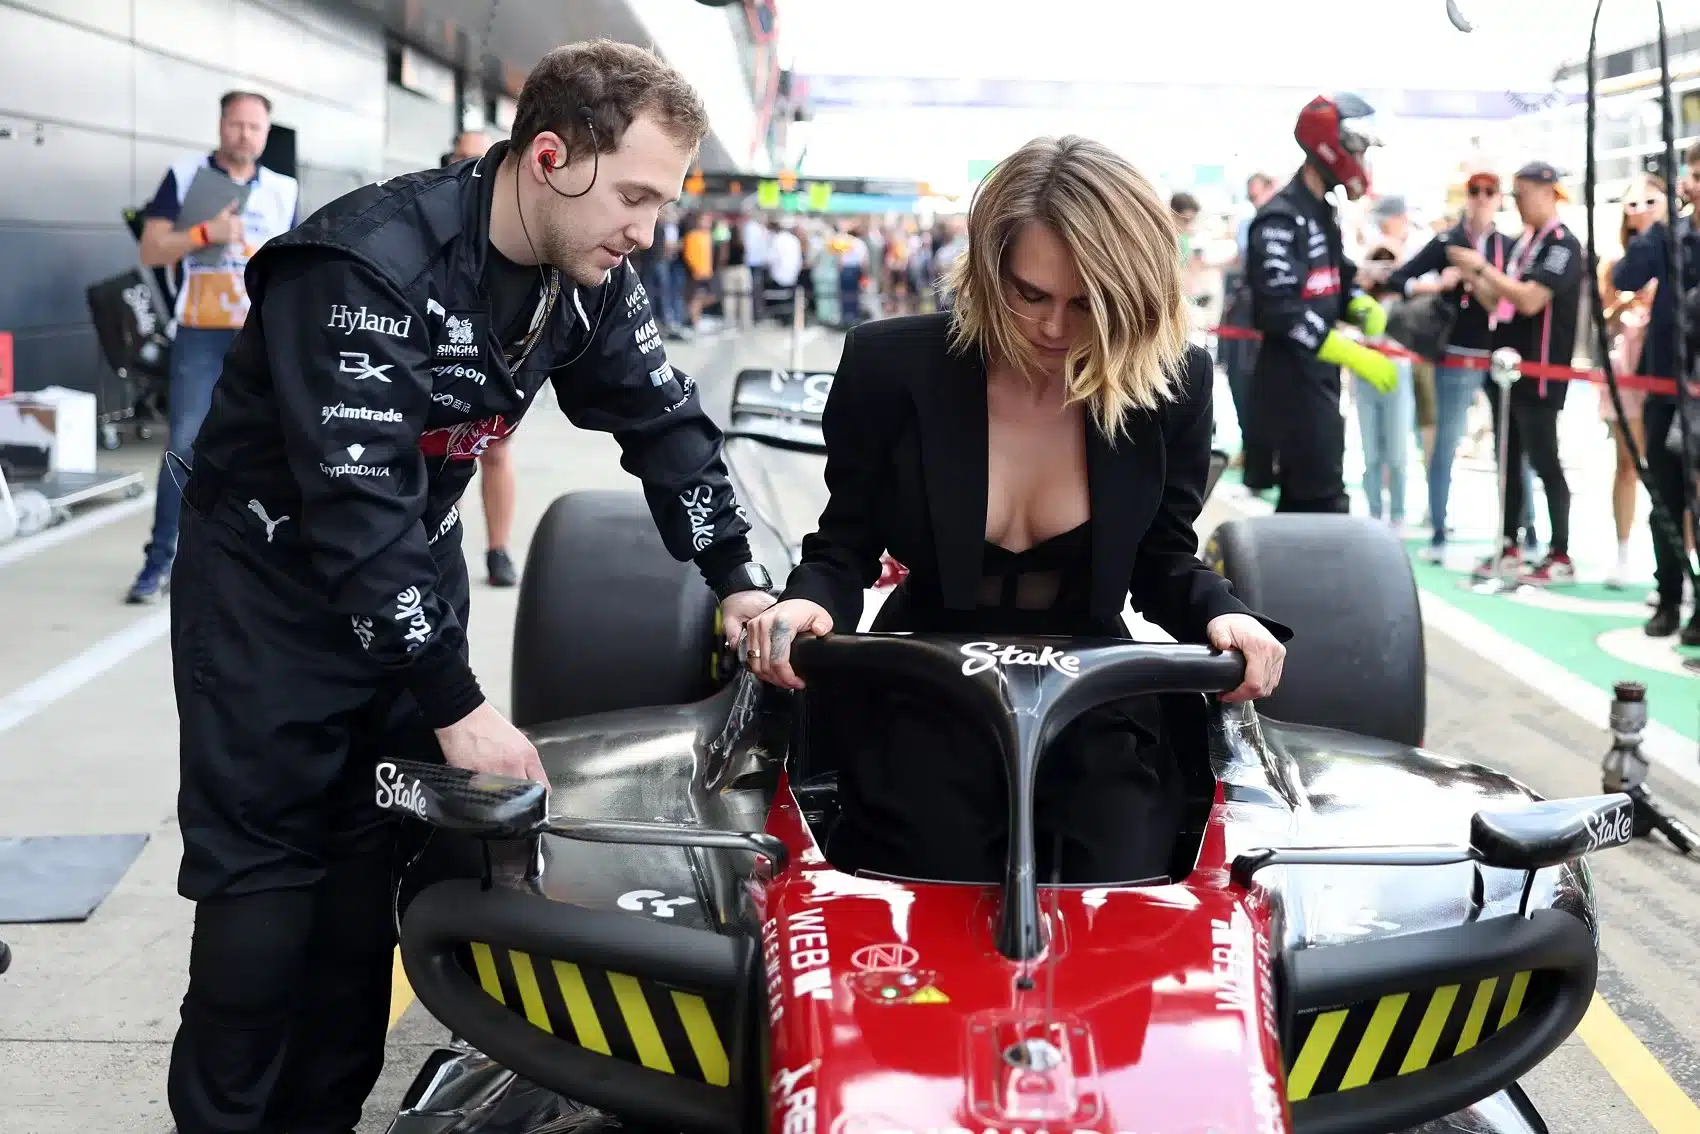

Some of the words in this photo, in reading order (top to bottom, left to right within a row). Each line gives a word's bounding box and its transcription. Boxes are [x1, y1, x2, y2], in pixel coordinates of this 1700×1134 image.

[327, 304, 412, 338] Hyland
[436, 344, 479, 353] SINGHA
[321, 400, 404, 425] aximtrade
[679, 484, 714, 551] Stake
[960, 641, 1080, 679] Stake
[375, 762, 428, 821] Stake
[1582, 807, 1632, 856] Stake
